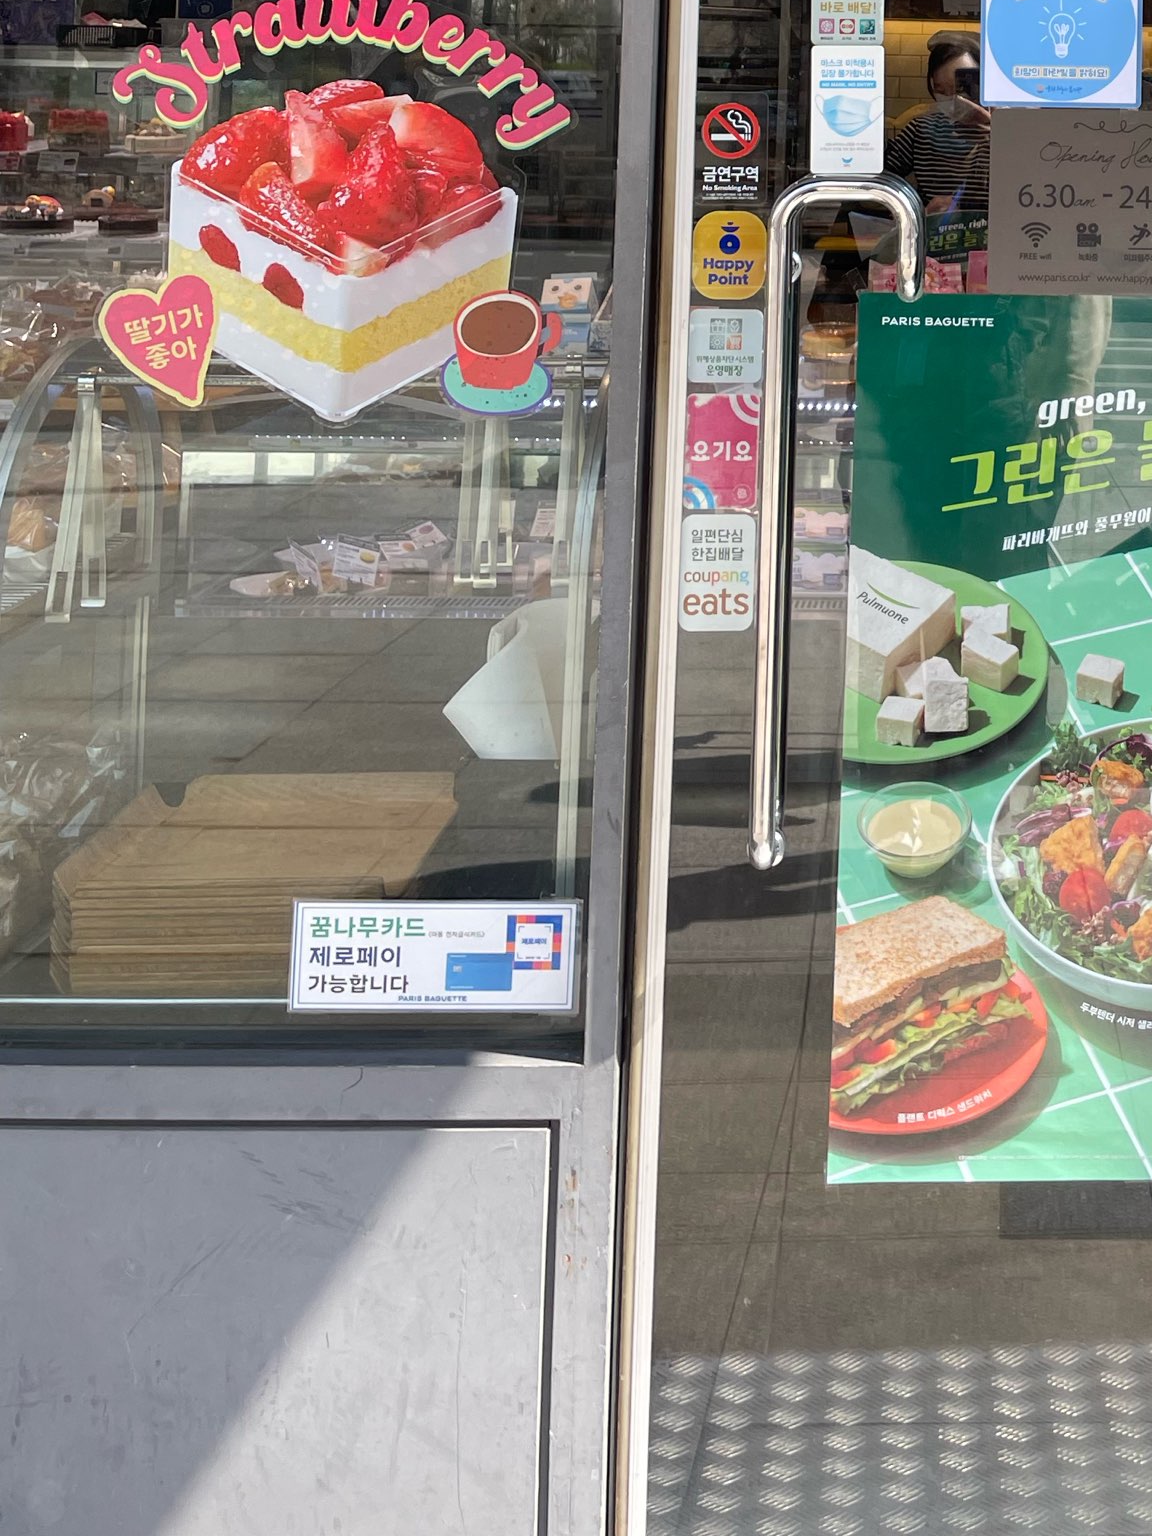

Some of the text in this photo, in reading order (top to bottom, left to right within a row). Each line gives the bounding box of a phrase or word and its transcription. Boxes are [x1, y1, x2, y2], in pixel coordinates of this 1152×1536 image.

[820, 1, 876, 14] 바로 배달!
[1039, 141, 1117, 172] Opening
[702, 166, 759, 182] 금연구역
[969, 219, 988, 230] righ
[703, 257, 753, 275] Happy
[708, 272, 749, 287] Point
[124, 304, 203, 344] 딸기가
[881, 316, 994, 328] PARIS BAGUETTE
[146, 340, 197, 370] 좋아
[1037, 386, 1145, 428] green,
[691, 441, 752, 462] 요기요
[941, 429, 1117, 512] 그린은
[691, 529, 743, 544] 일편단심
[1002, 523, 1089, 551] 파리바게뜨와
[1094, 507, 1151, 534] 풀무원이
[691, 547, 744, 562] 한집배달
[684, 570, 750, 586] coupang
[683, 588, 749, 616] eats
[857, 590, 910, 626] Pulmuone
[309, 916, 426, 939] 꿈나무카드
[309, 946, 401, 968] 제로페이
[308, 974, 409, 994] 가능합니다
[1117, 1016, 1135, 1028] 시저
